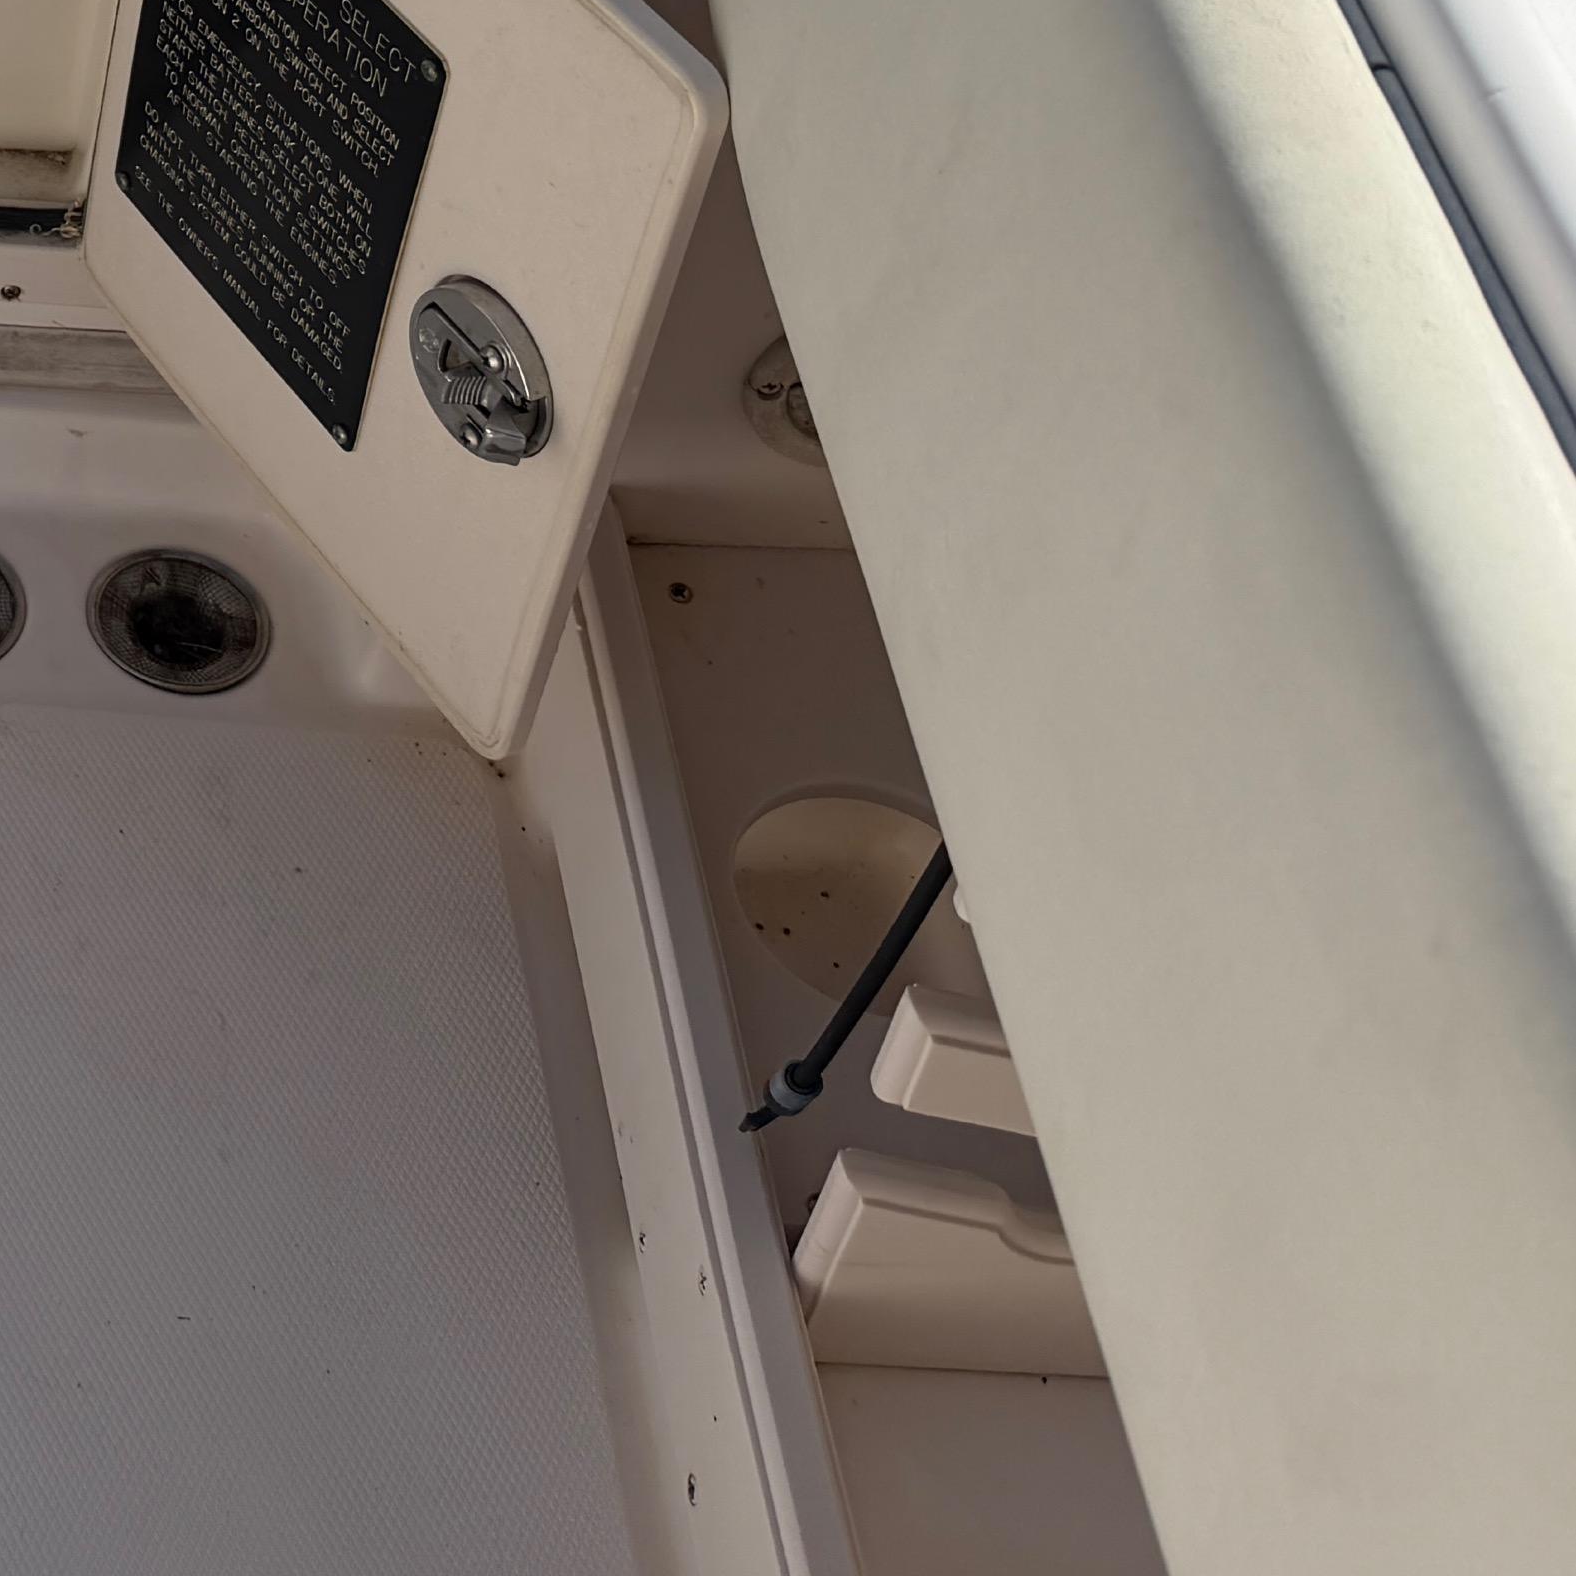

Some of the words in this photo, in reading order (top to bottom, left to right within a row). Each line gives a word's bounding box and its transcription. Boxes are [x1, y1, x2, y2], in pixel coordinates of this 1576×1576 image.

[156, 34, 184, 73] EACH
[233, 120, 277, 175] RETURN
[283, 173, 303, 206] THE
[309, 204, 366, 275] SWITCHES
[159, 18, 193, 60] START
[199, 59, 216, 90] THE
[271, 143, 314, 193] SELECT
[318, 193, 350, 235] BOTH
[354, 233, 372, 258] ON
[162, 0, 206, 55] NEITHER
[209, 52, 262, 113] BATTERY
[264, 114, 296, 153] BANK
[300, 155, 339, 202] ALONE
[346, 200, 373, 241] WILL
[166, 89, 201, 128] AFTER
[206, 131, 257, 196] STARTING
[265, 195, 285, 227] THE
[197, 18, 262, 92] EMERGENCY
[266, 92, 332, 171] SITUATIONS
[338, 170, 373, 215] WHEN
[245, 27, 262, 51] ON
[267, 48, 289, 82] THE
[293, 79, 327, 117] PORT
[283, 46, 323, 95] SWITCH
[326, 92, 348, 120] AND
[352, 118, 395, 166] SELECT
[304, 46, 347, 93] SELECT
[350, 92, 400, 151] POSITION
[135, 165, 152, 192] SEE
[158, 191, 173, 218] THE
[222, 269, 261, 321] MANUAL
[266, 319, 288, 348] FOR
[139, 134, 185, 192] CHARGING
[189, 191, 230, 243] SYSTEM
[234, 242, 267, 286] COULD
[271, 285, 286, 308] BE
[144, 101, 159, 123] DO
[163, 121, 184, 150] NOT
[190, 153, 216, 189] TURN
[219, 186, 256, 234] EITHER
[262, 234, 303, 287] SWITCH
[309, 285, 324, 310] TO
[328, 311, 351, 337] OFF
[146, 121, 172, 157] WITH
[178, 157, 196, 186] THE
[201, 184, 244, 241] ENGINES
[248, 239, 294, 297] RUNNING
[299, 297, 316, 321] OR
[323, 322, 343, 354] THE
[165, 62, 178, 86] TO
[182, 84, 223, 139] NORMAL
[230, 138, 291, 212] OPERATION
[295, 211, 351, 280] SETTINGS
